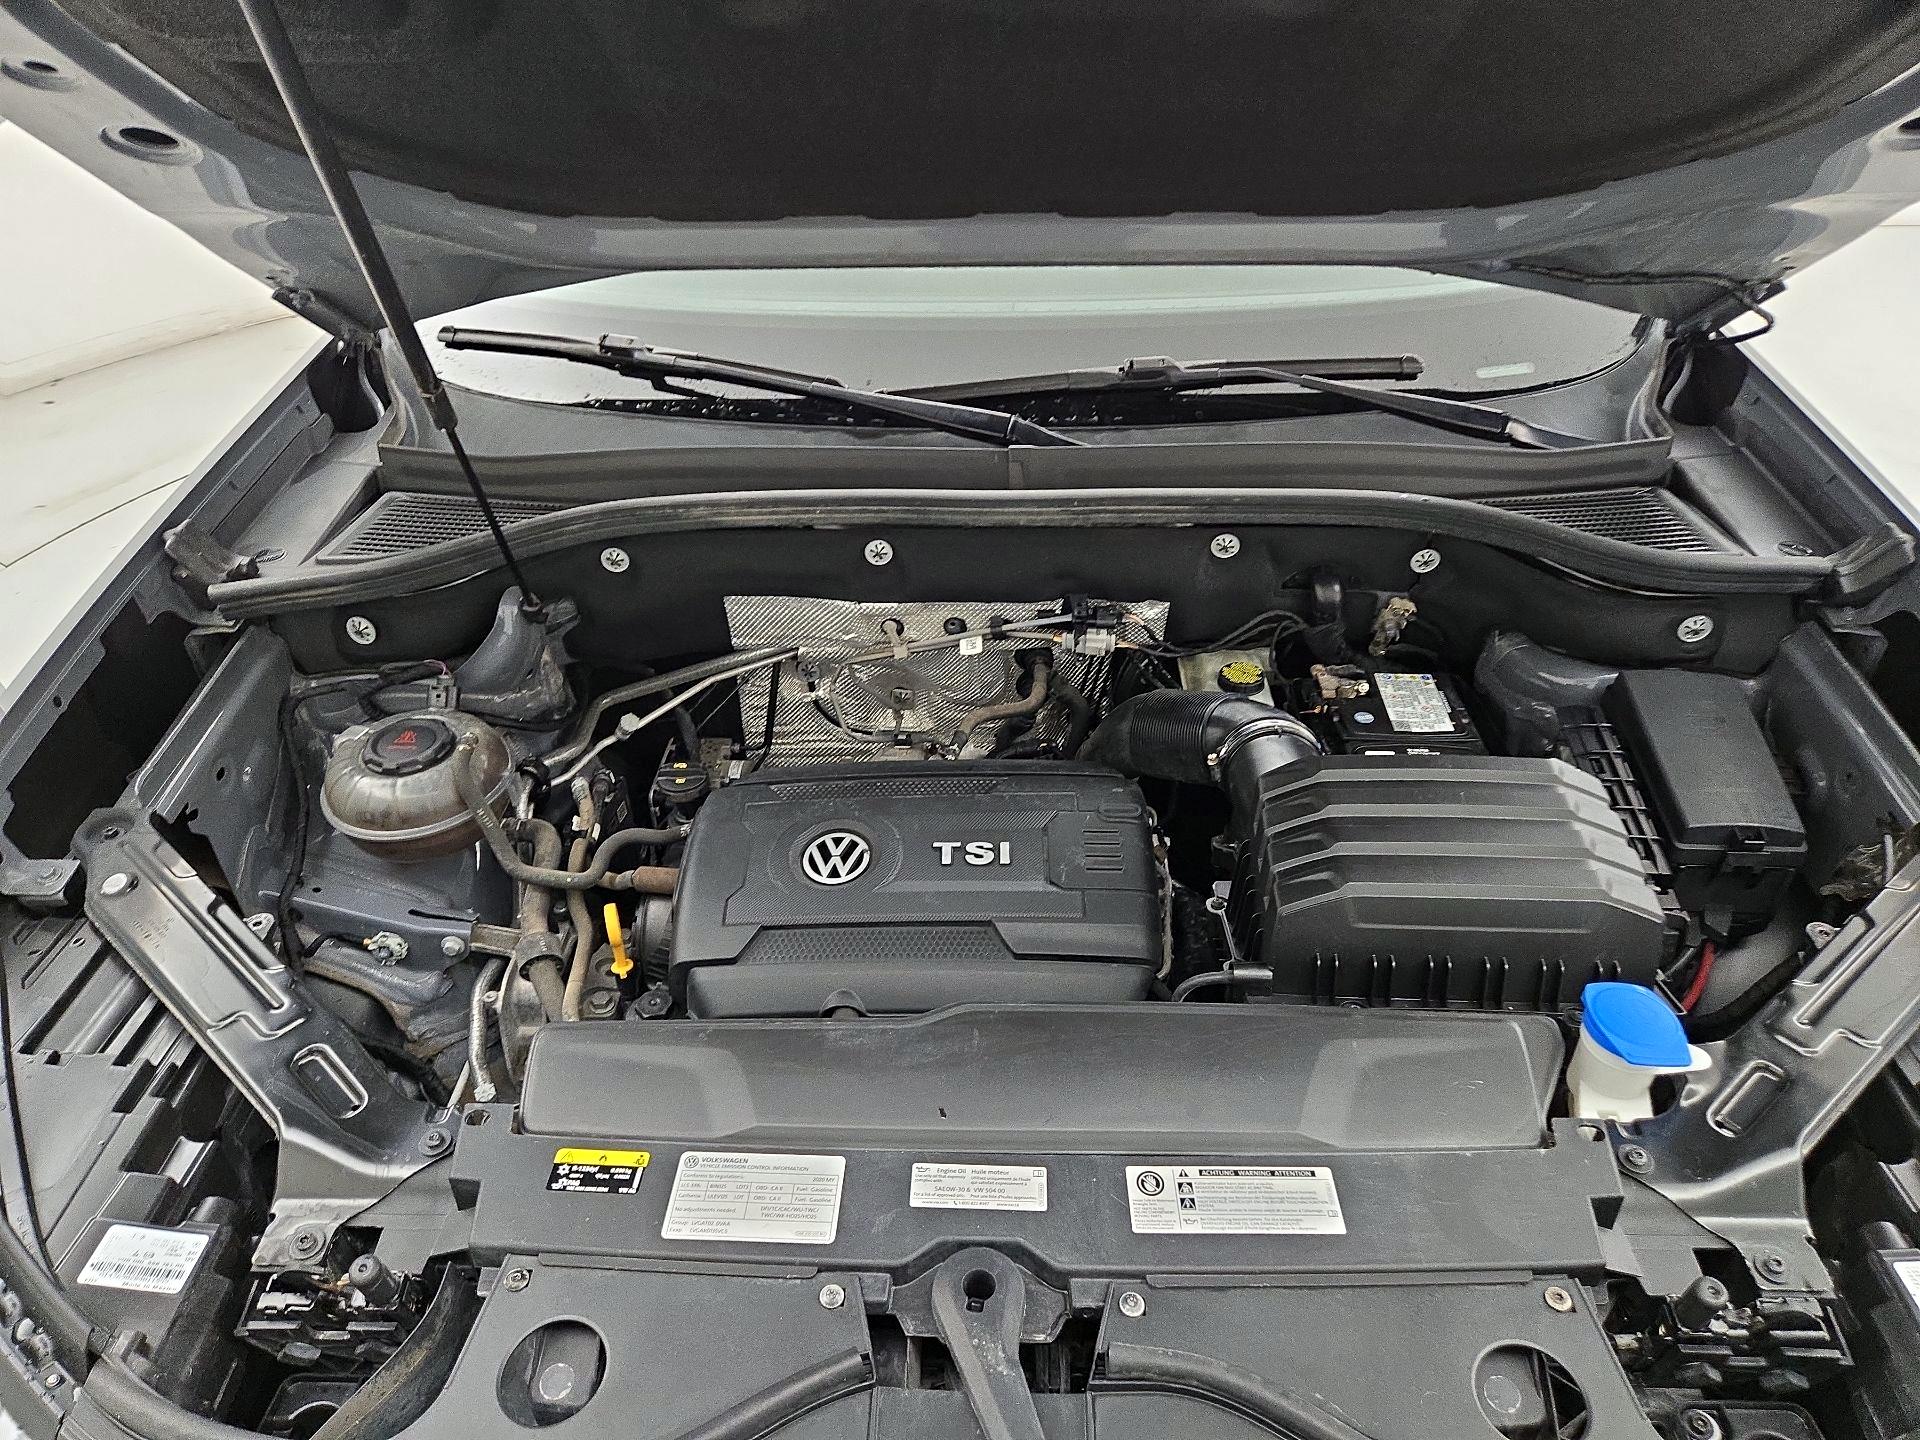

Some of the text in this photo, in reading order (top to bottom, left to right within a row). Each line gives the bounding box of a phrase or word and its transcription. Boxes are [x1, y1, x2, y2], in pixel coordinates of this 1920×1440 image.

[802, 832, 870, 885] VW
[932, 841, 1010, 866] TSI
[701, 1156, 749, 1164] VOLKSWAGEN
[1237, 1169, 1272, 1177] WARNING
